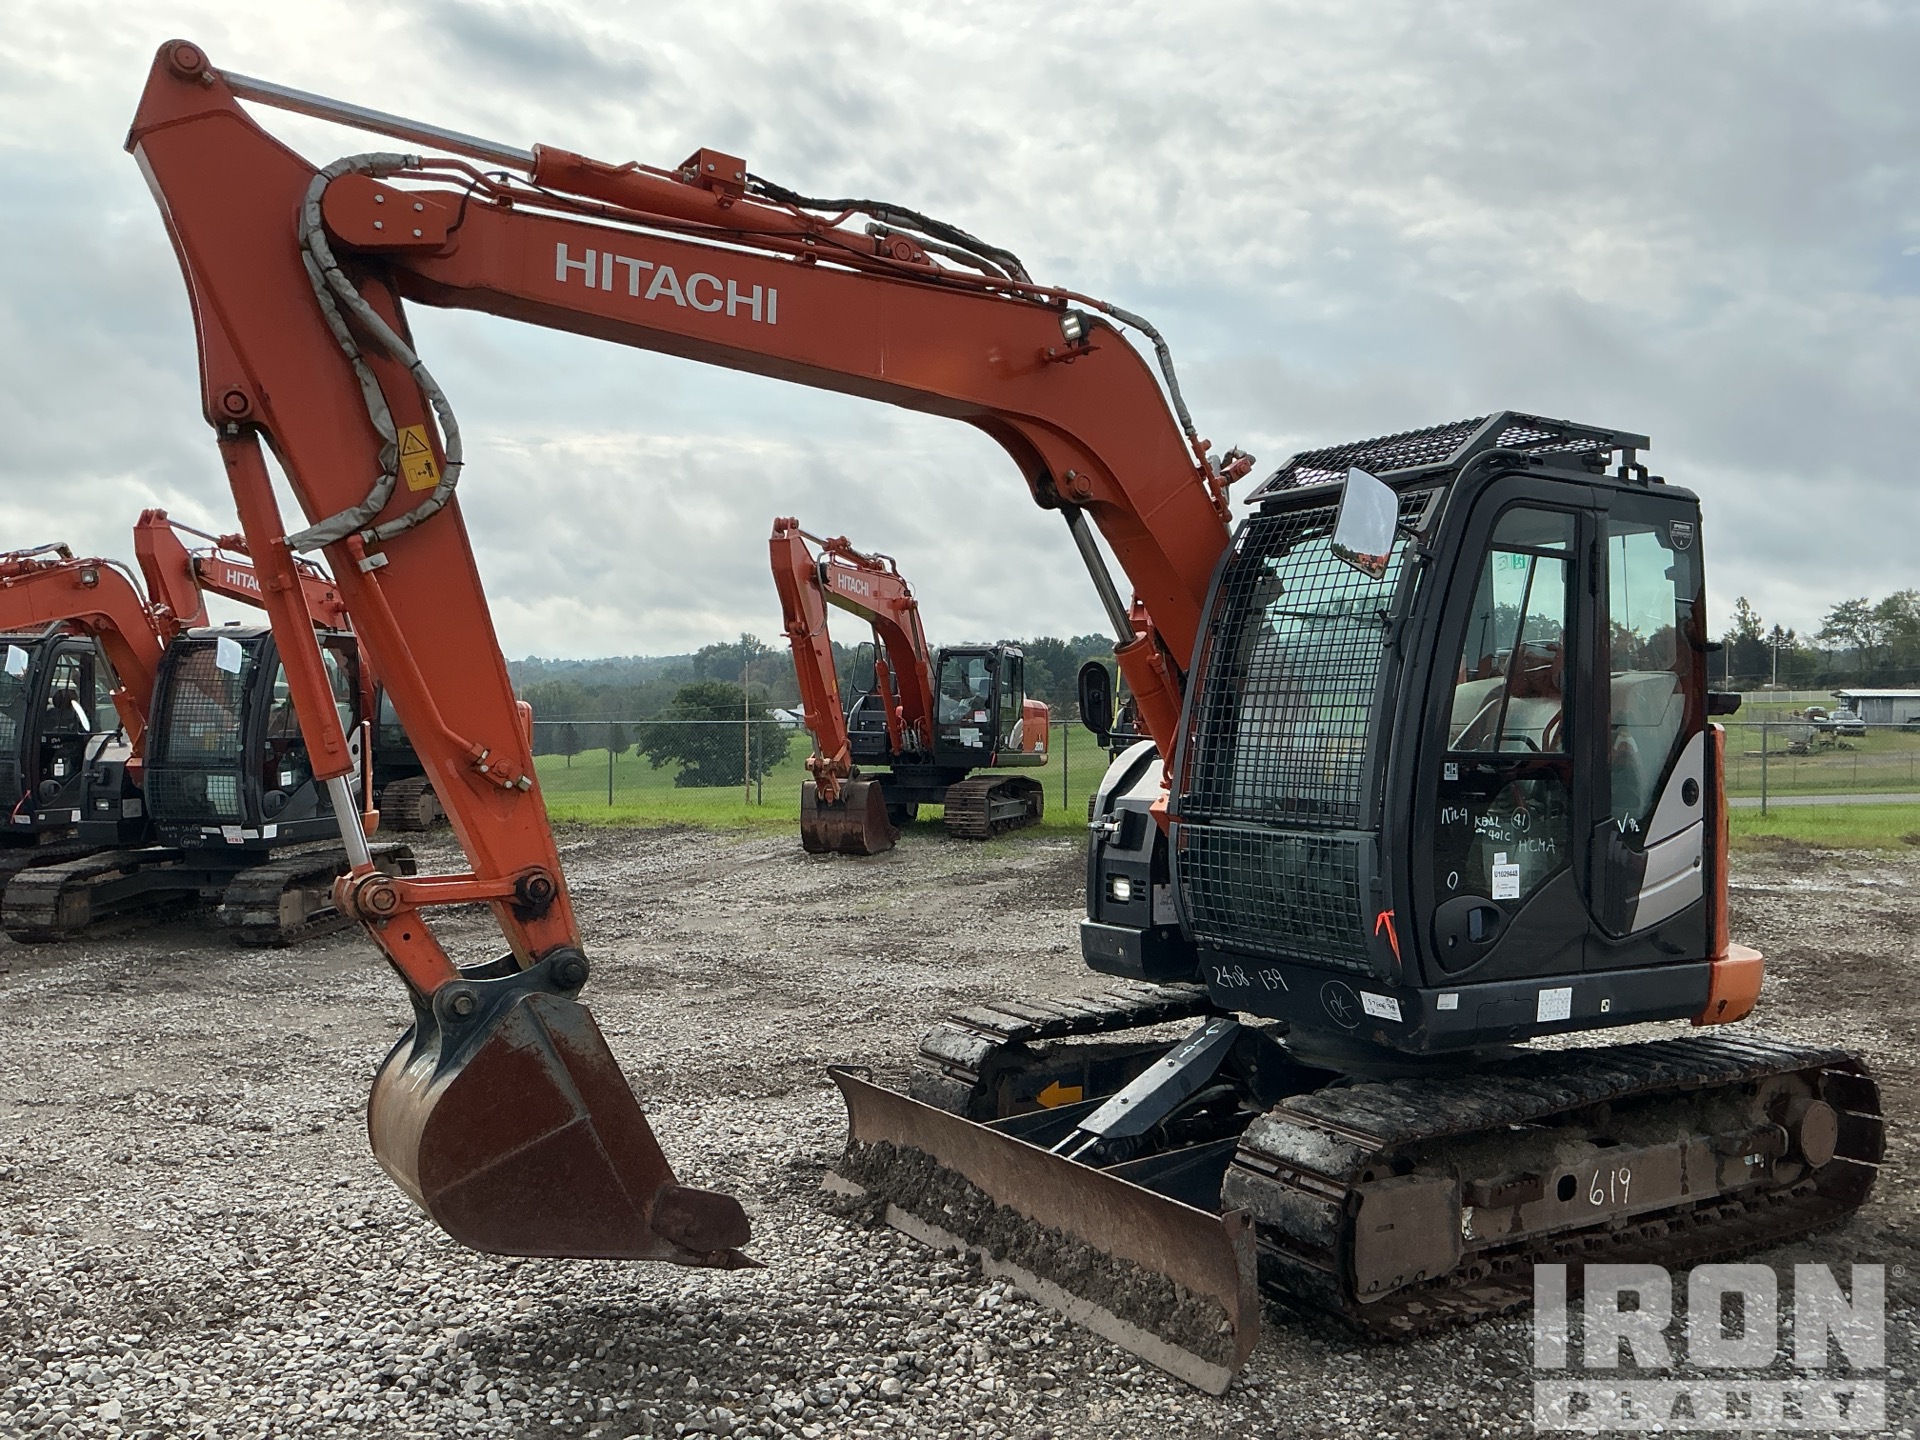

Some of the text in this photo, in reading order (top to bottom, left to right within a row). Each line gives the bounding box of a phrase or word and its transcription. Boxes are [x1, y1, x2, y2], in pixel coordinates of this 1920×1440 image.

[555, 242, 777, 325] HITACHI
[837, 572, 869, 597] HITACHI
[1518, 837, 1556, 855] HCMA
[1589, 1167, 1632, 1206] 619
